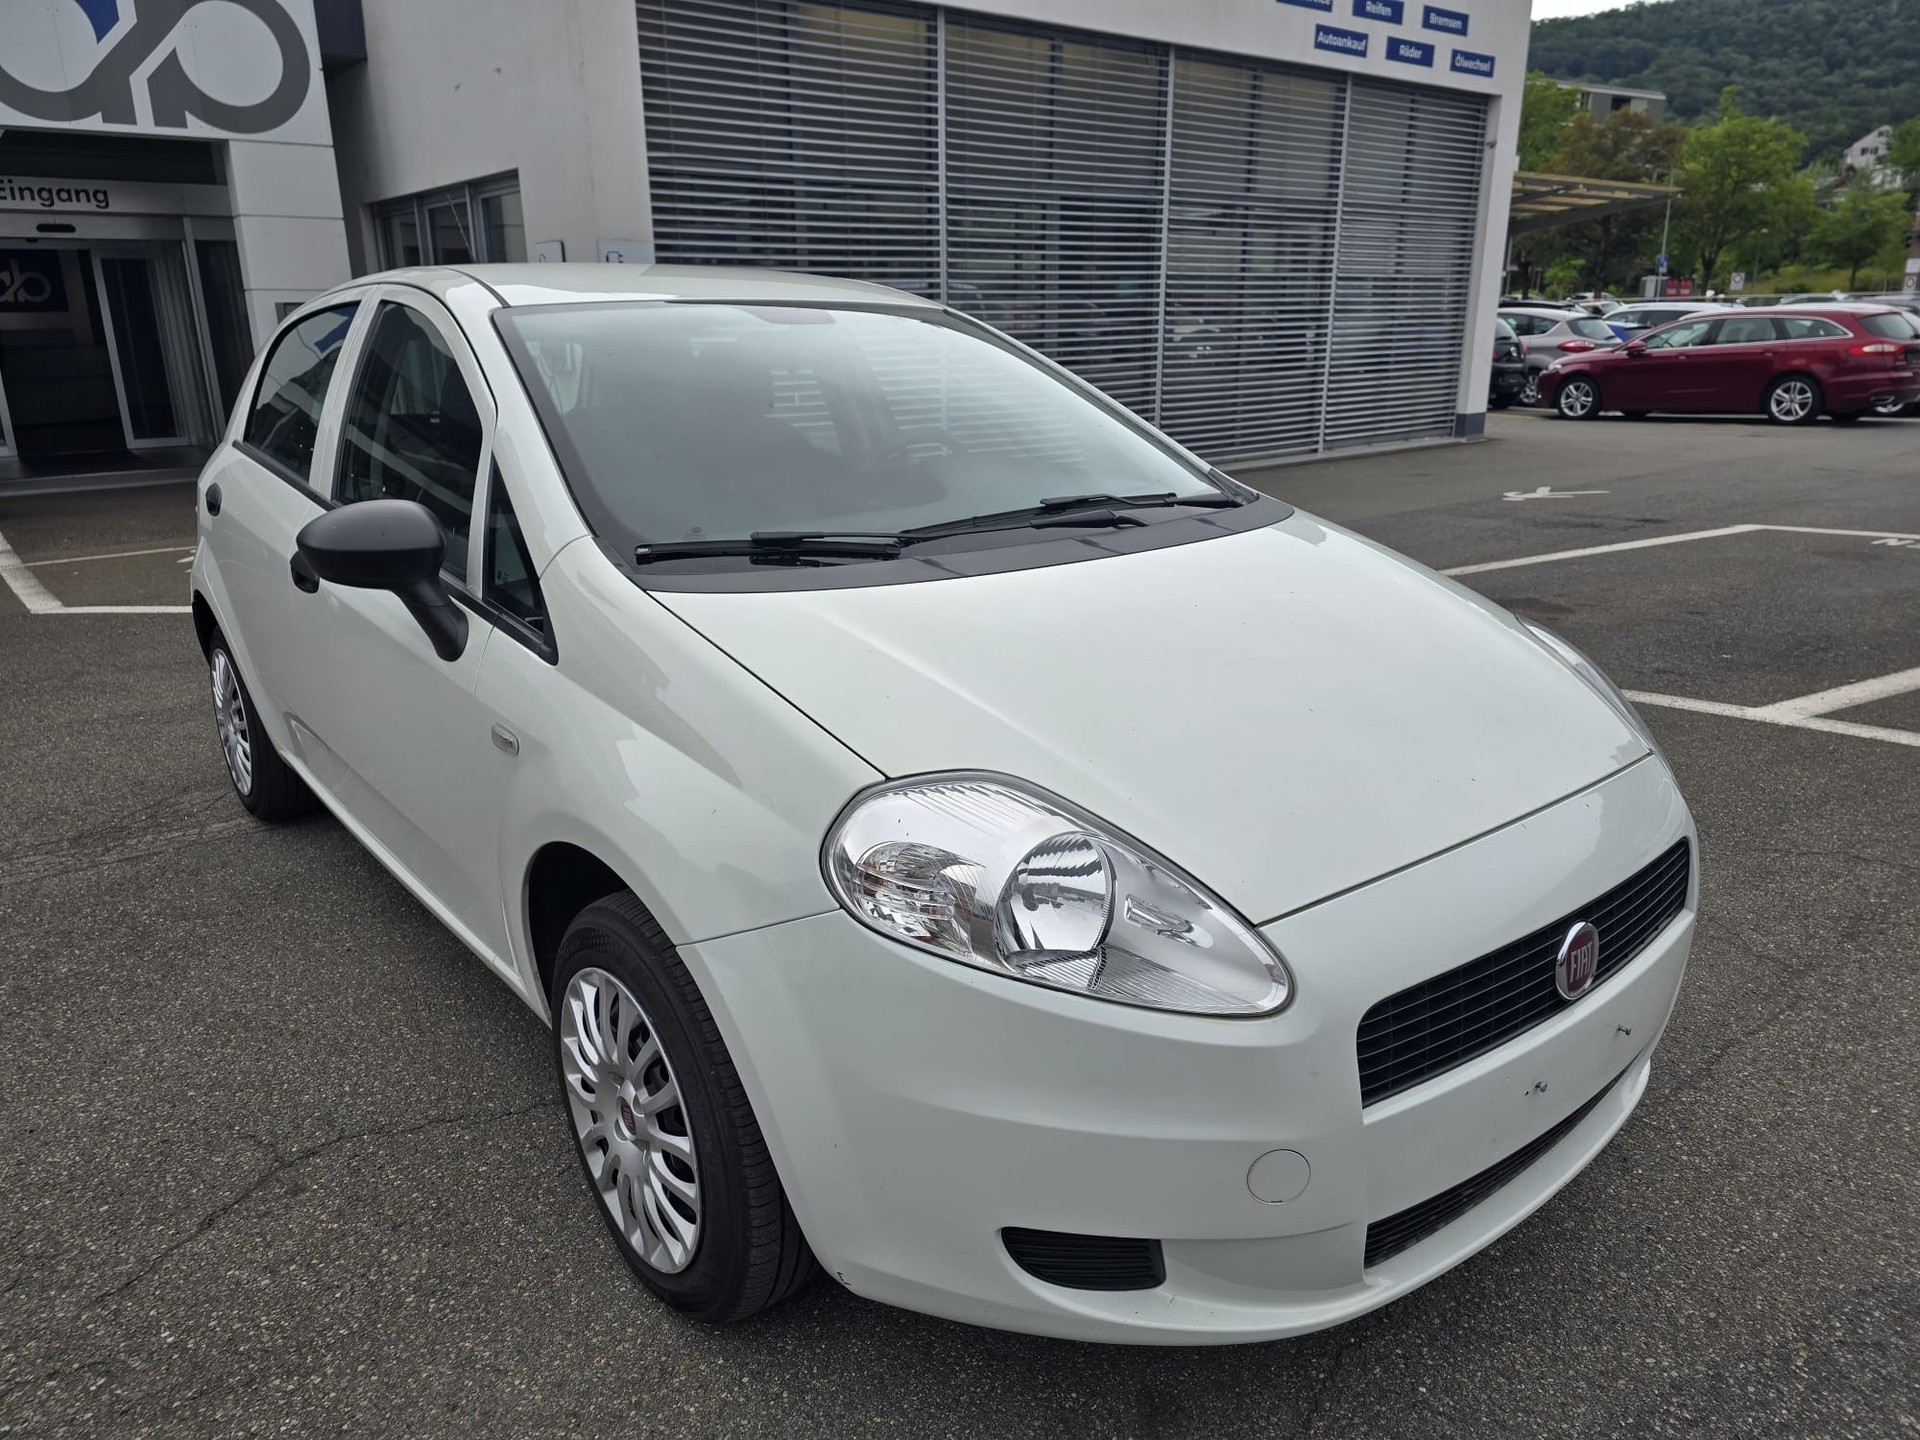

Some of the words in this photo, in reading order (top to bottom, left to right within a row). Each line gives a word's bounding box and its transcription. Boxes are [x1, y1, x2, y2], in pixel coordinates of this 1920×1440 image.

[1366, 1, 1392, 17] Reifen
[1317, 32, 1367, 51] Autoankauf
[1455, 53, 1492, 72] Ölwechsel
[1569, 941, 1593, 983] FIAT
